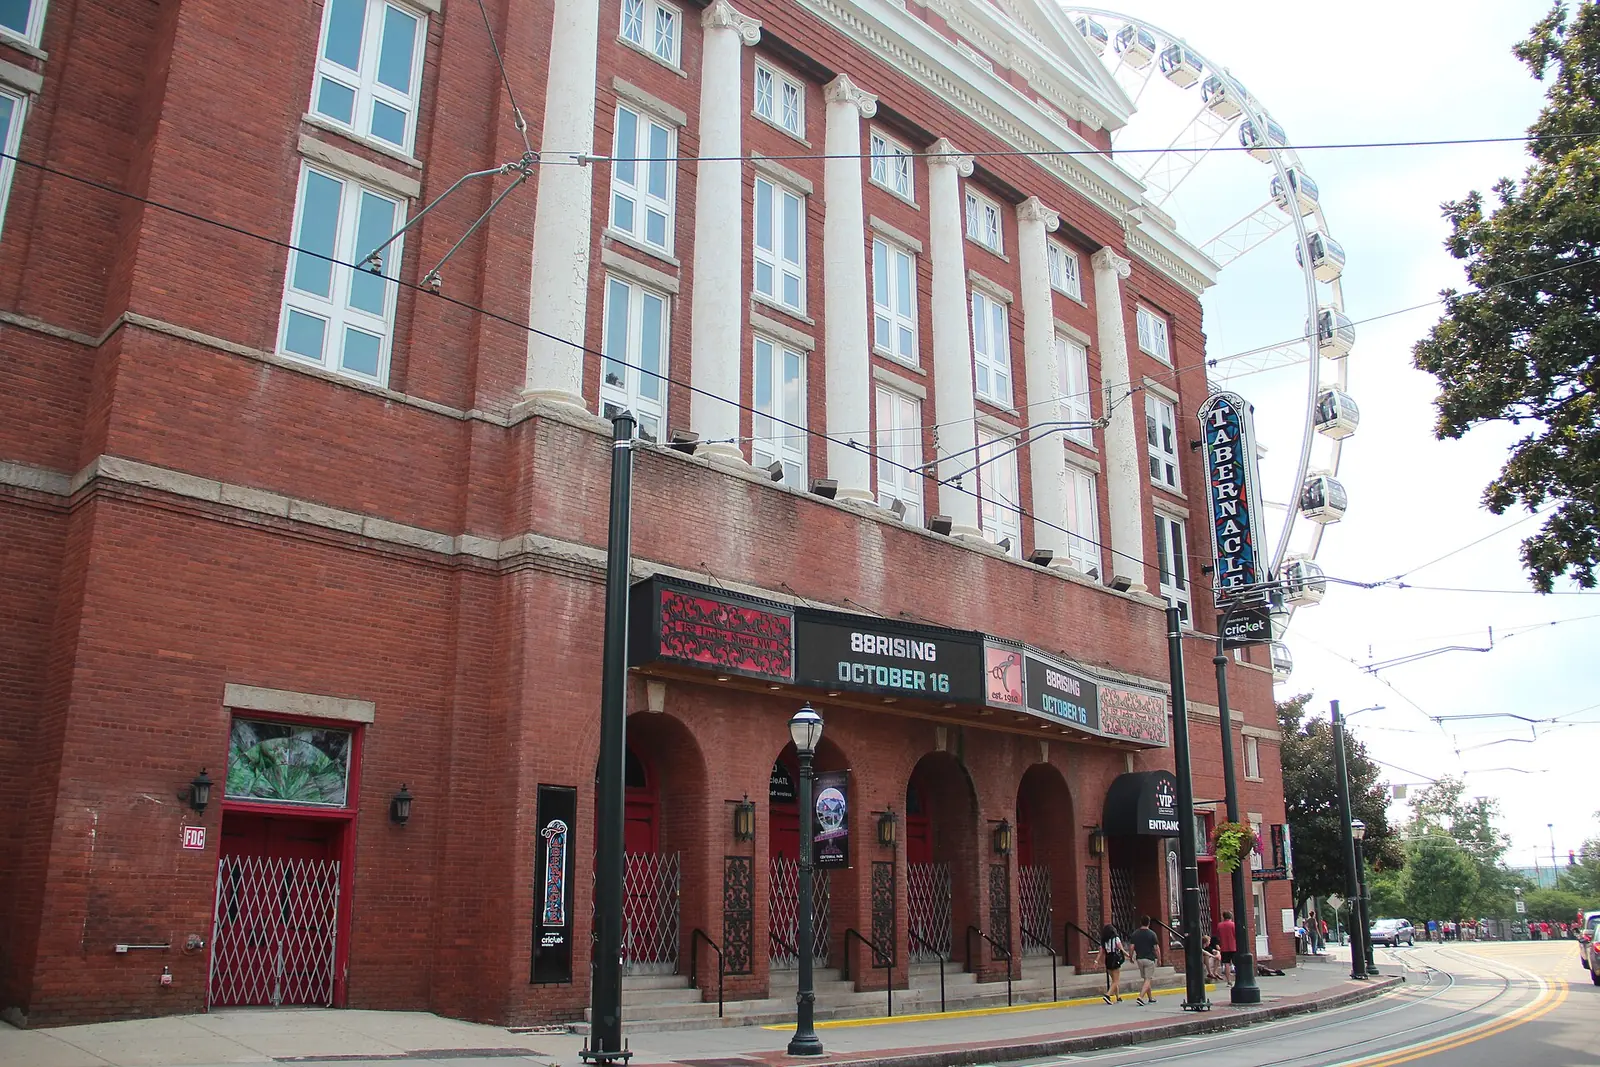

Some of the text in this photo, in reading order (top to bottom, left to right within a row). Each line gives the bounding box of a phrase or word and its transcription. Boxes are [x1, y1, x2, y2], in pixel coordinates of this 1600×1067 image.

[1208, 406, 1244, 592] TABERNACLE
[681, 623, 770, 649] 152 Luckie Street NW
[1225, 620, 1265, 636] cricket
[851, 632, 936, 662] 88RISING
[838, 661, 950, 693] OCTOBER 16
[1046, 669, 1080, 697] 88RISING
[991, 692, 1018, 703] est. 1910
[1042, 694, 1087, 724] OCTOBER 16
[1159, 794, 1173, 807] VIP
[185, 830, 204, 846] FDC
[1149, 820, 1180, 831] ENTRANC
